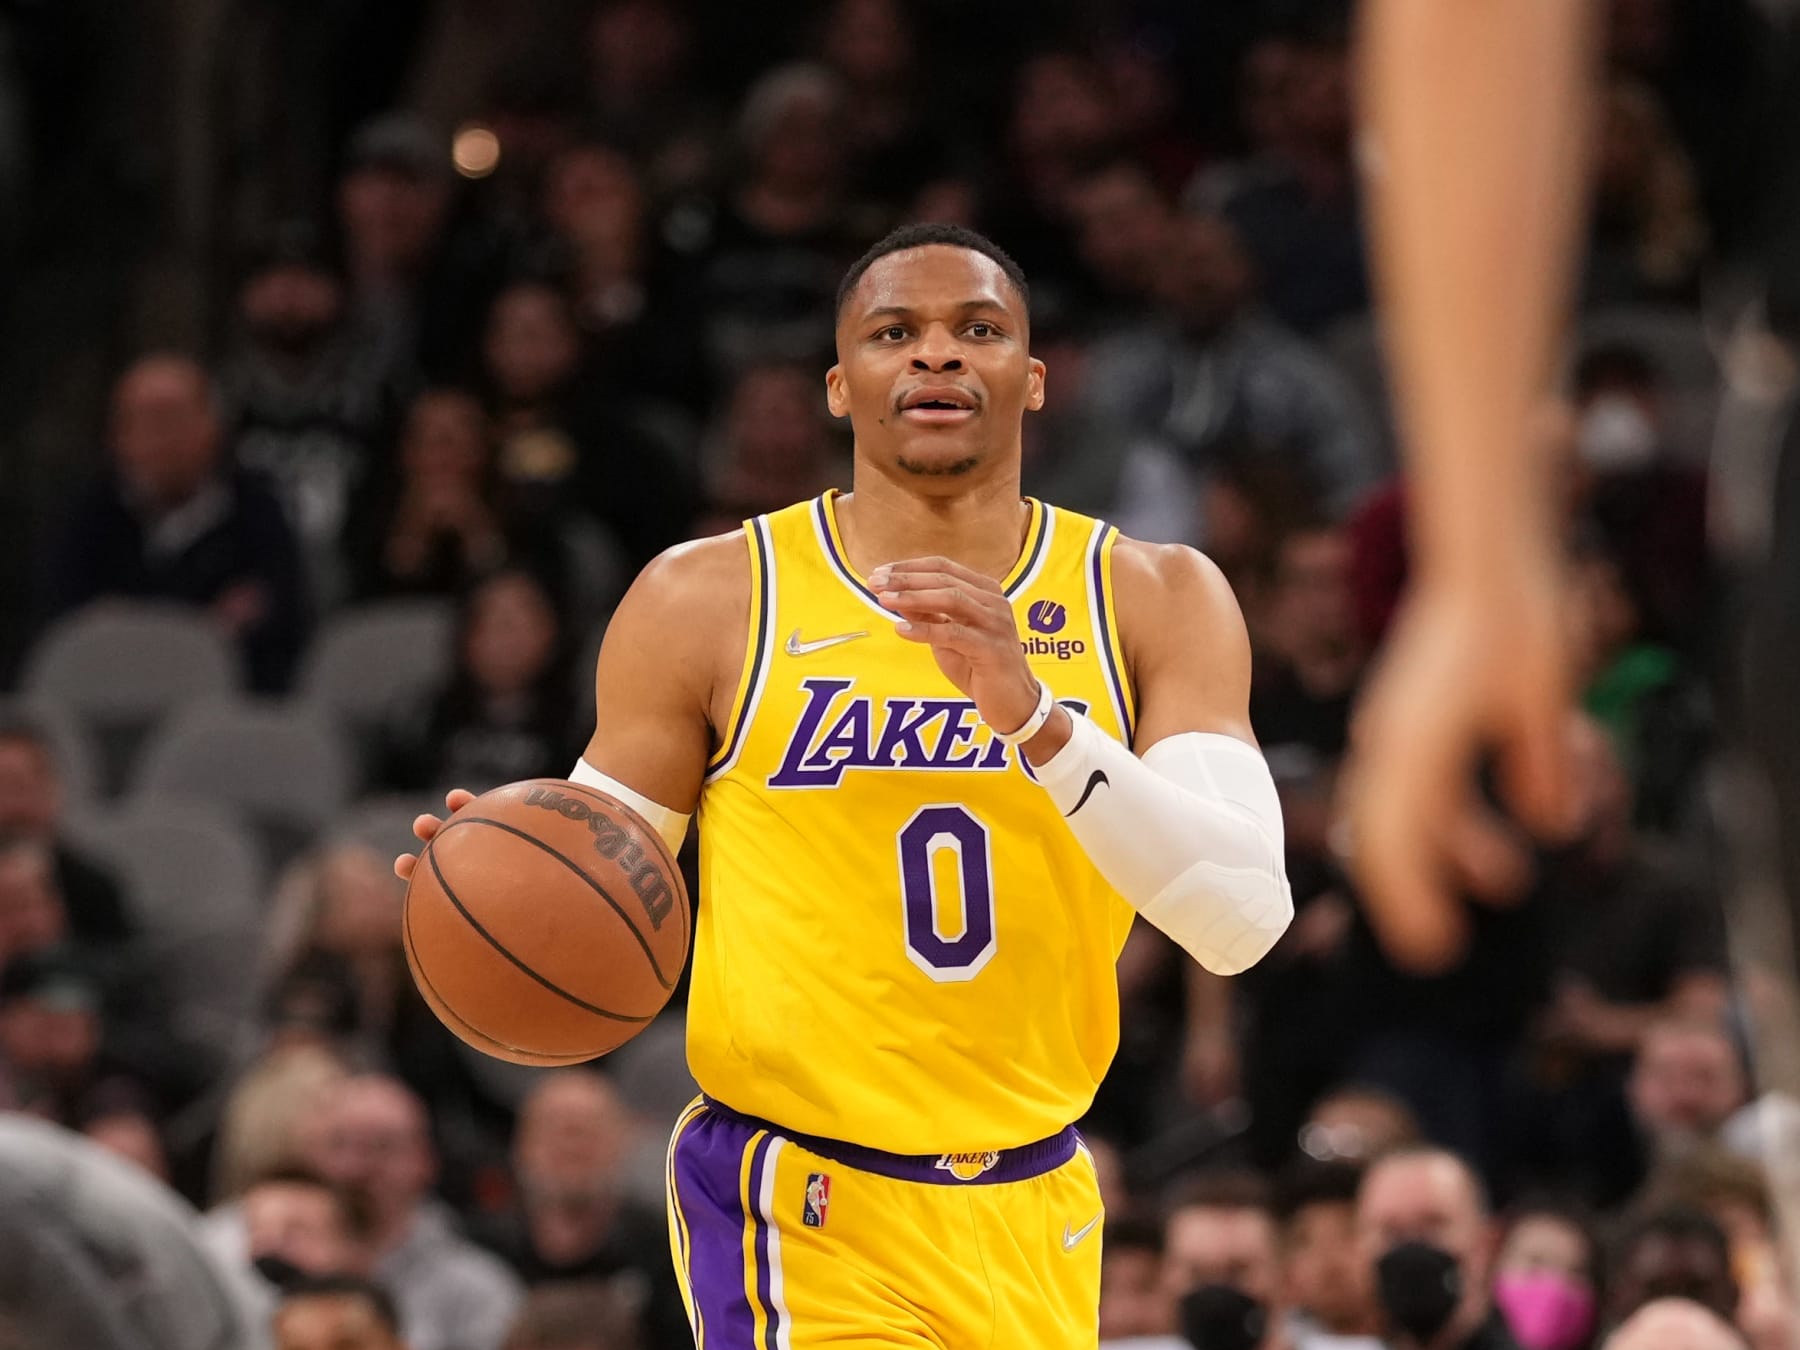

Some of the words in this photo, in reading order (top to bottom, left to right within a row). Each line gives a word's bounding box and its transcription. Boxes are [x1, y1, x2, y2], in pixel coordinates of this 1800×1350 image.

[766, 677, 1090, 788] LAKE
[523, 788, 674, 932] Wilson
[896, 802, 997, 982] 0
[806, 1212, 814, 1224] 75
